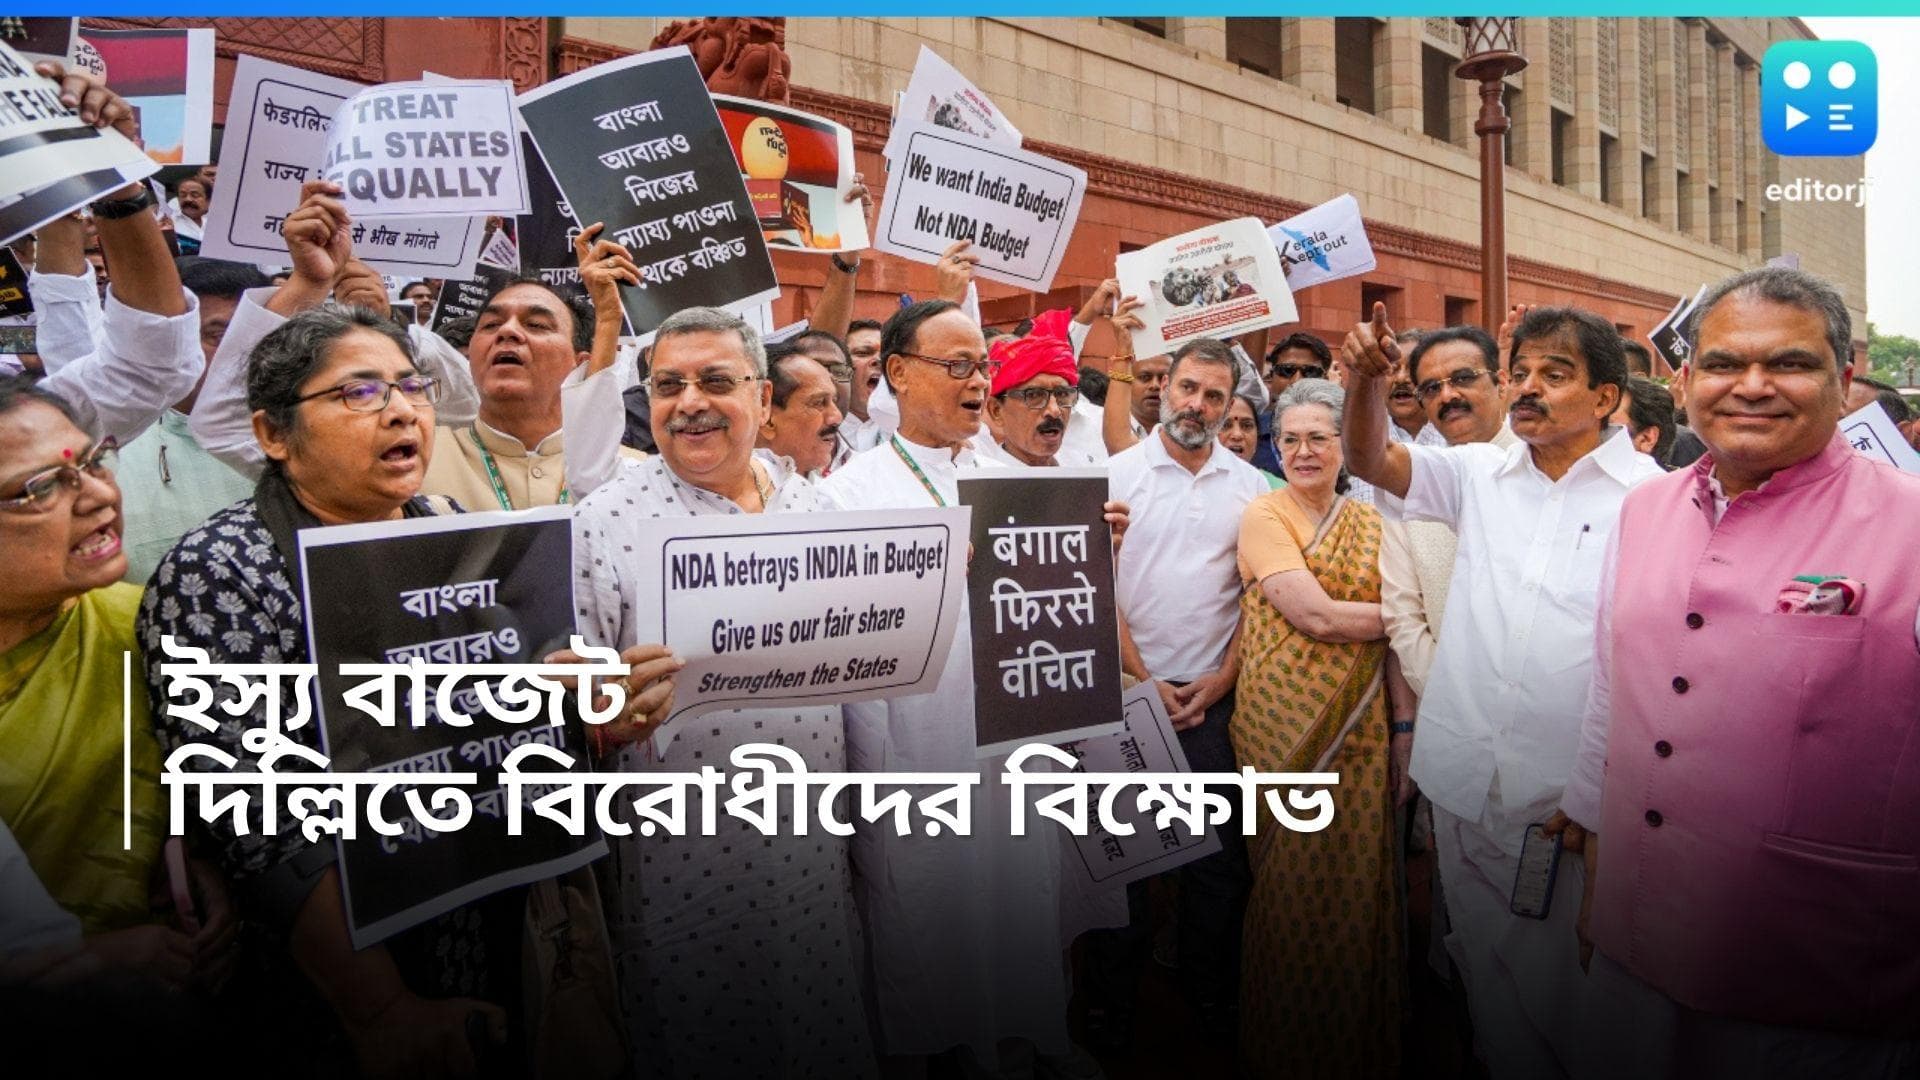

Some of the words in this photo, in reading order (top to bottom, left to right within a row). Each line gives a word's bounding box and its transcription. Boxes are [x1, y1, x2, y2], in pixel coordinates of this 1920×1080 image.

[354, 93, 459, 124] TREAT
[593, 100, 664, 132] বাংলা
[385, 130, 510, 158] STATES
[598, 134, 691, 170] আবারও
[264, 160, 309, 184] राज्य
[329, 166, 502, 203] EQUALLY
[624, 171, 699, 206] নিজের
[908, 153, 932, 181] We
[936, 165, 974, 194] want
[975, 170, 1012, 204] India
[1014, 183, 1065, 223] Budget
[369, 225, 399, 248] भीख
[403, 227, 441, 250] मांगते
[613, 217, 672, 250] ন্যায্য
[672, 200, 738, 233] পাওনা
[914, 205, 944, 236] Not
[945, 212, 977, 245] NDA
[979, 222, 1030, 261] Budget
[1323, 235, 1348, 252] out
[689, 236, 747, 271] বঞ্চিত
[988, 516, 1090, 566] बंगाल
[671, 553, 718, 590] NDA
[724, 554, 800, 592] betrays
[806, 543, 858, 580] INDIA
[863, 543, 879, 576] in
[884, 539, 944, 579] Budget
[400, 579, 499, 618] বাংলা
[990, 571, 1097, 634] फिरसे
[711, 618, 755, 655] Give
[761, 622, 783, 648] us
[789, 619, 820, 644] our
[823, 607, 855, 640] fair
[857, 601, 906, 633] share
[697, 668, 804, 694] Strengthen
[809, 664, 840, 686] the
[842, 655, 899, 682] States
[999, 640, 1096, 698] वंचित
